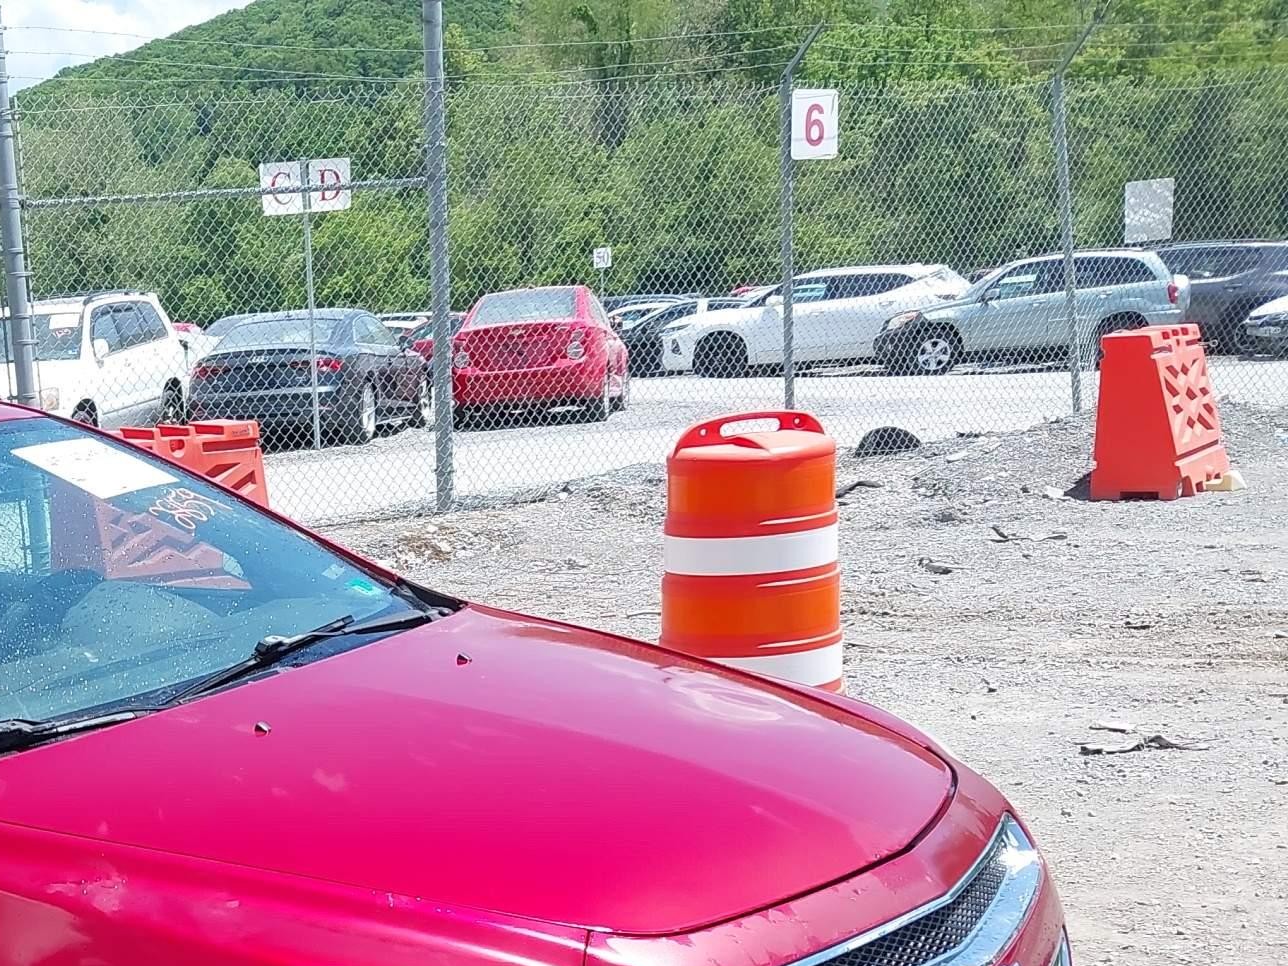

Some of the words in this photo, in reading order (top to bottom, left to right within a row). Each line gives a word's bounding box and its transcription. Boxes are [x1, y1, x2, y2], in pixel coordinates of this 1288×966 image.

[805, 103, 825, 147] 6
[270, 171, 293, 206] C
[318, 168, 342, 202] D
